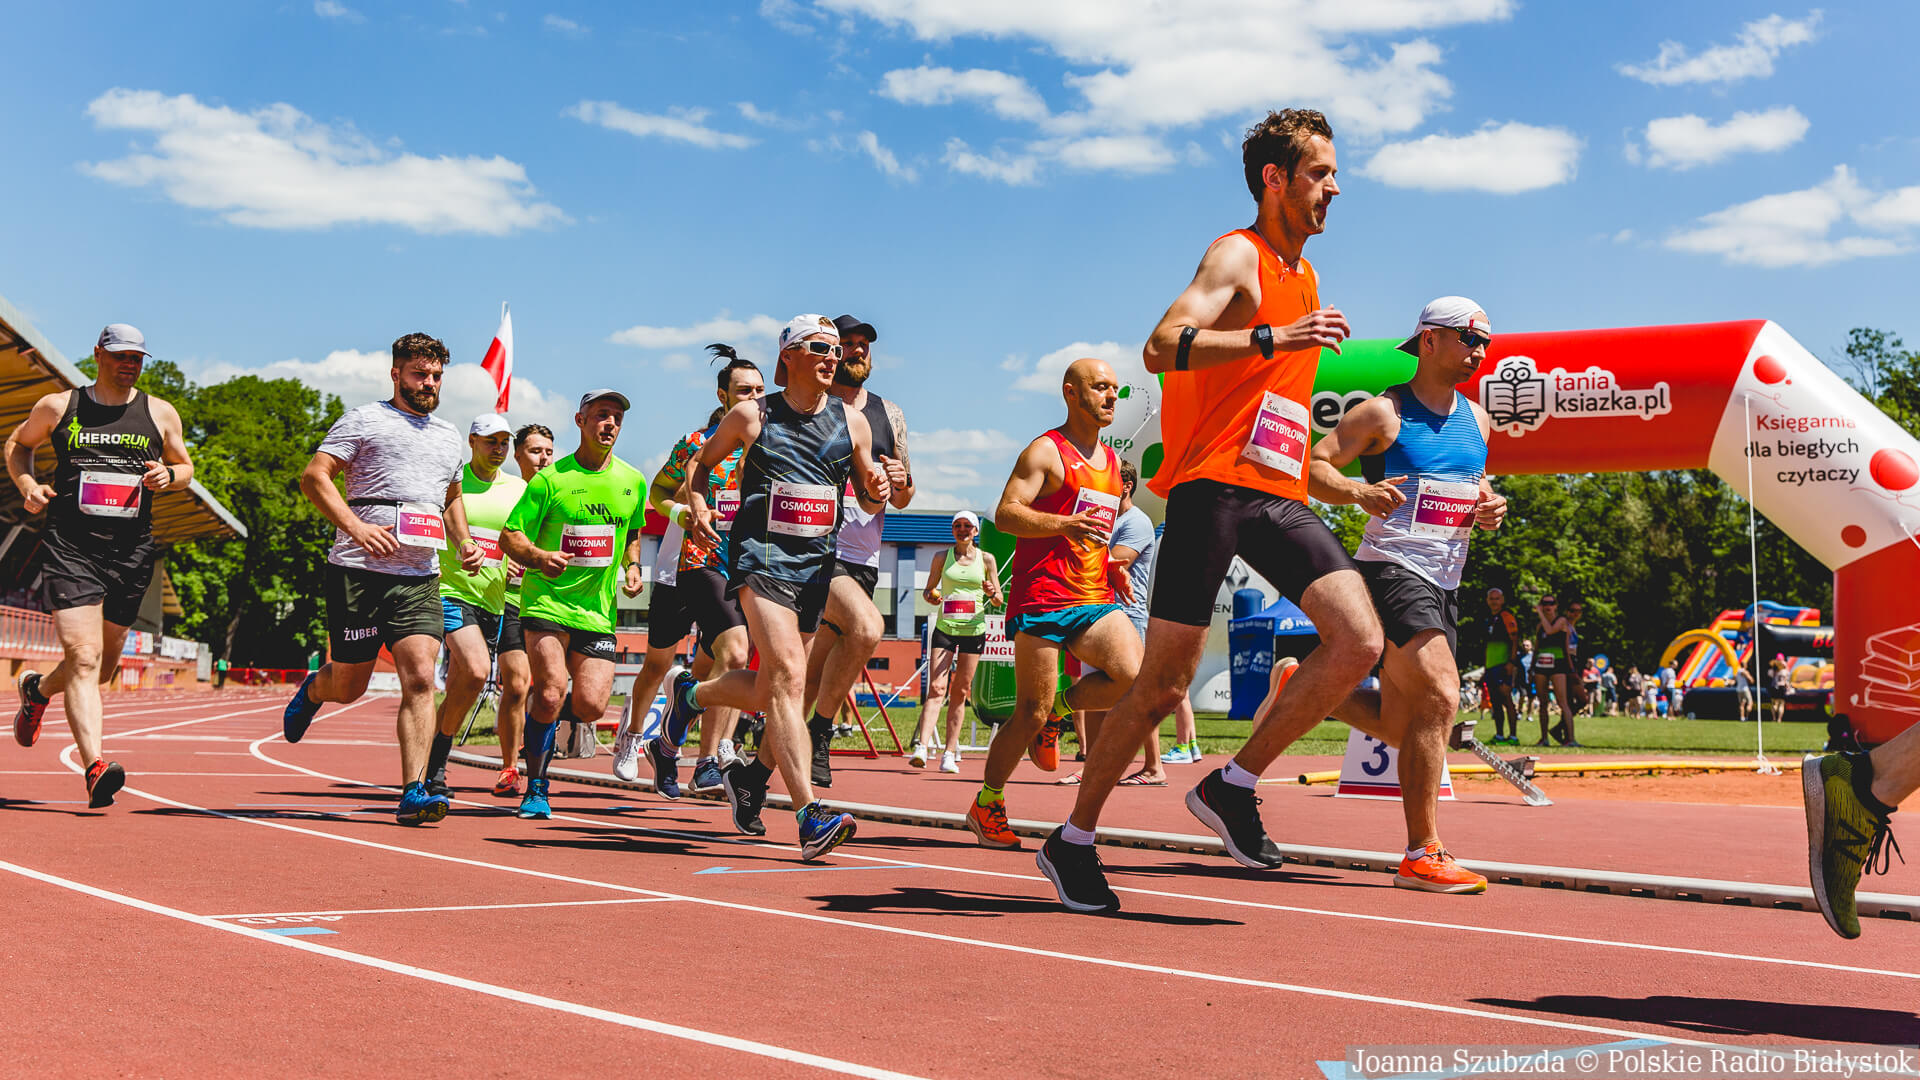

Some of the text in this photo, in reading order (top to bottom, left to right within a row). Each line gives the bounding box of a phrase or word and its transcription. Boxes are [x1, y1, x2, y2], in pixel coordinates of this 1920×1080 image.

[1555, 372, 1609, 391] tania
[1555, 387, 1666, 415] ksiazka.pl
[1756, 413, 1856, 433] Księgarnia
[80, 432, 150, 449] HERORUN
[1101, 435, 1133, 452] klep
[1280, 442, 1289, 453] 63
[1744, 438, 1859, 459] dla biegłych
[1777, 468, 1860, 487] czytaczy
[780, 500, 829, 513] OSMÓLSKI
[797, 515, 812, 523] 110
[1445, 516, 1454, 525] 16
[568, 538, 607, 548] WOŹNIAK
[344, 627, 378, 641] ŻUBER
[643, 708, 662, 740] 2
[1361, 735, 1389, 776] 3
